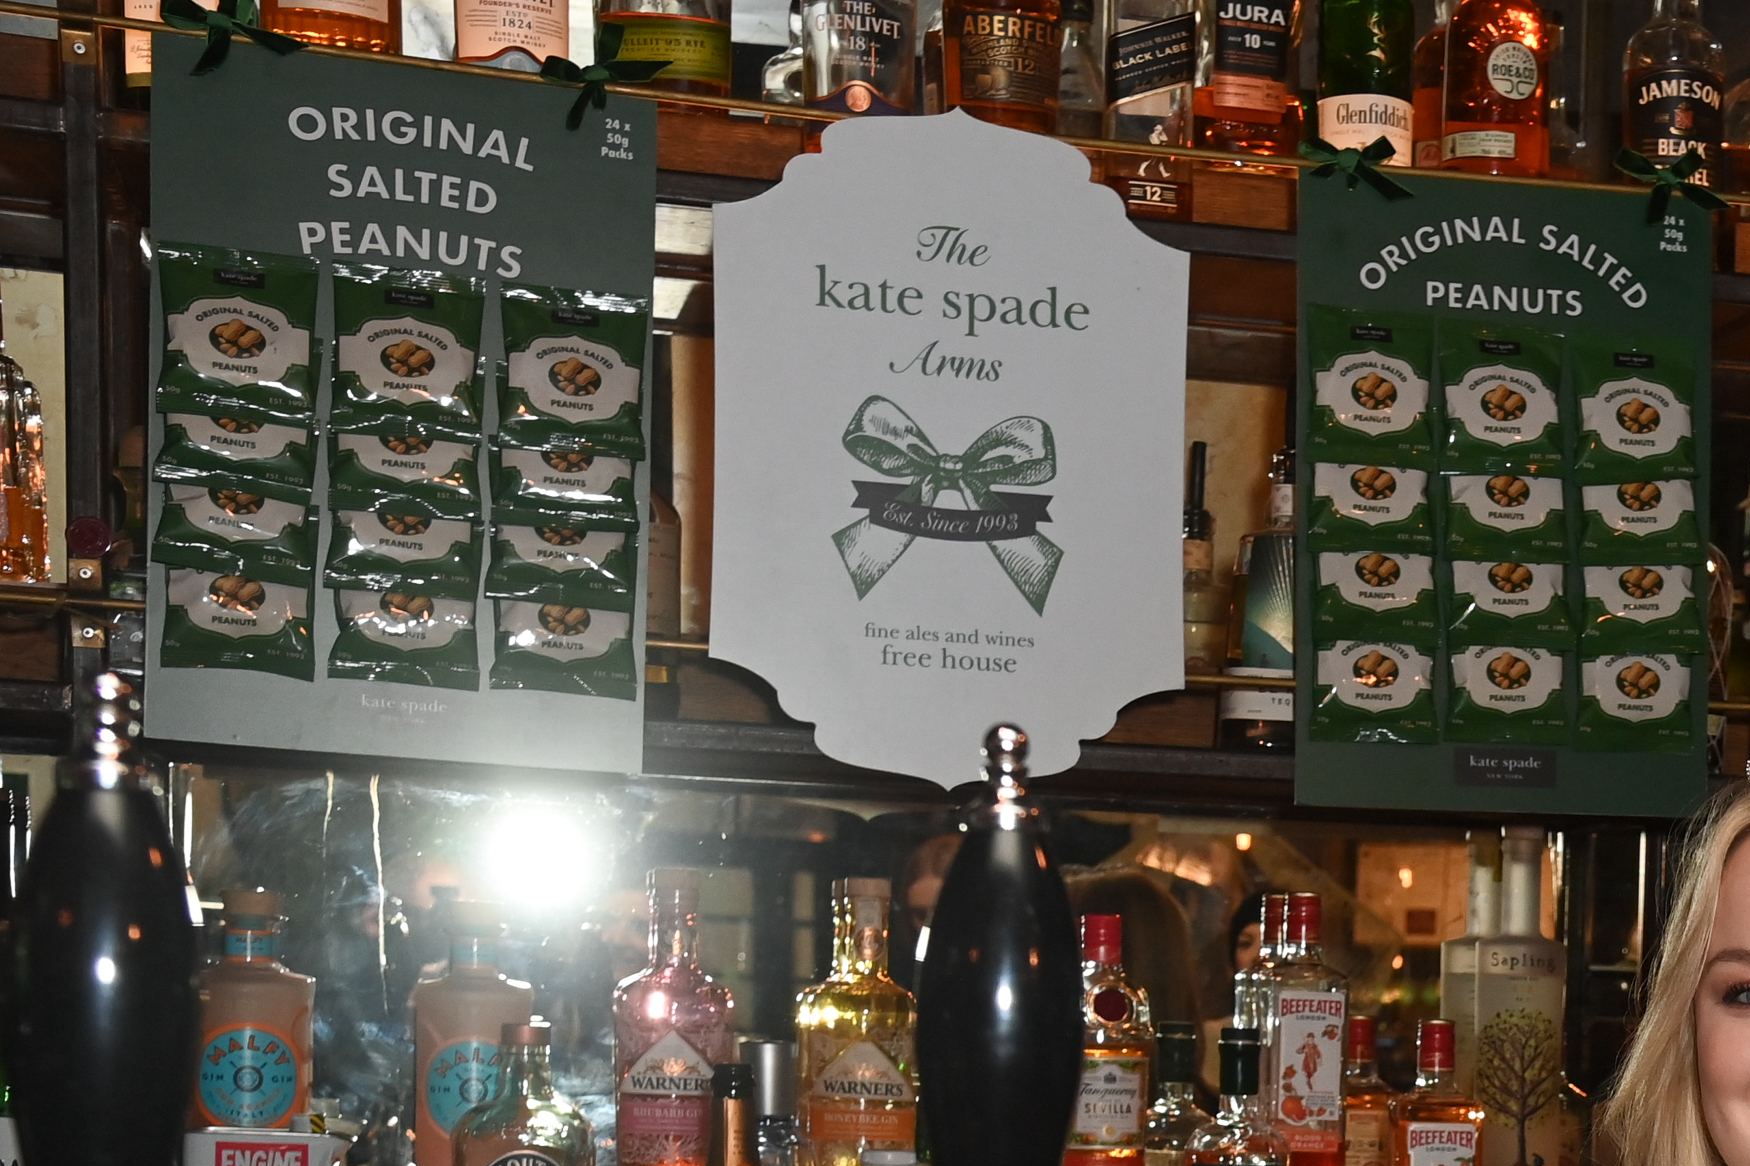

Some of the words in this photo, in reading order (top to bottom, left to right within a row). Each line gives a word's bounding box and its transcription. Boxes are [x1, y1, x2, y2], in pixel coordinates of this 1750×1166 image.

[844, 0, 872, 15] THE
[1219, 3, 1286, 26] JURA
[502, 17, 532, 30] 1824
[814, 15, 901, 40] GLENLIVET
[850, 35, 866, 51] 18
[1244, 34, 1261, 49] 10
[1112, 53, 1153, 70] BLACK
[1638, 79, 1721, 110] JAMESON
[605, 118, 620, 130] 24
[1336, 103, 1410, 132] Glenfiddich
[288, 106, 534, 172] ORIGINAL
[606, 132, 629, 148] 50g
[600, 146, 634, 160] Packs
[327, 163, 497, 214] SALTED
[1144, 185, 1162, 201] 12
[1663, 215, 1676, 227] 24
[1664, 228, 1684, 242] 50g
[298, 220, 522, 278] PEANUTS
[916, 225, 992, 267] The
[1659, 241, 1688, 252] Packs
[1359, 216, 1526, 290] ORIGINAL
[1538, 224, 1648, 309] SALTED
[815, 264, 924, 316] kate
[942, 286, 1090, 337] spade
[1426, 280, 1583, 317] PEANUTS
[195, 306, 245, 323] ORIGINAL
[247, 310, 280, 333] SALTED
[367, 327, 415, 343] ORIGINAL
[417, 330, 448, 351] SALTED
[536, 346, 580, 360] ORIGINAL
[583, 348, 614, 370] SALTED
[889, 340, 1003, 382] Arms
[212, 361, 258, 374] PEANUTS
[383, 380, 428, 392] PEANUTS
[550, 399, 594, 412] PEANUTS
[1353, 413, 1391, 424] PEANUTS
[1484, 425, 1522, 434] PEANUTS
[210, 435, 257, 449] PEANUTS
[1619, 437, 1656, 447] PEANUTS
[381, 458, 426, 470] PEANUTS
[542, 475, 586, 487] PEANUTS
[1352, 503, 1391, 514] PEANUTS
[1488, 511, 1525, 521] PEANUTS
[882, 502, 913, 527] Est.
[920, 511, 969, 534] Since
[974, 513, 1019, 534] 1993
[1621, 516, 1658, 524] PEANUTS
[379, 537, 423, 550] PEANUTS
[1358, 590, 1396, 600] PEANUTS
[1492, 597, 1530, 606] PEANUTS
[212, 615, 257, 627] PEANUTS
[864, 621, 900, 639] fine
[905, 625, 939, 642] ales
[945, 629, 979, 645] and
[985, 631, 1035, 648] wines
[541, 639, 584, 651] PEANUTS
[881, 644, 932, 668] free
[941, 648, 1018, 673] house
[361, 693, 396, 708] kate
[401, 699, 448, 714] spade
[1355, 692, 1393, 702] PEANUTS
[1489, 693, 1526, 703] PEANUTS
[1617, 703, 1654, 712] PEANUTS
[1469, 754, 1499, 768] kate
[1502, 756, 1542, 771] spade
[1491, 951, 1557, 972] Sapling
[1281, 997, 1342, 1018] BEEFEATER
[207, 1034, 290, 1066] MALFY
[823, 1078, 904, 1098] WARNER'S
[1410, 1129, 1474, 1150] BEEFEATER
